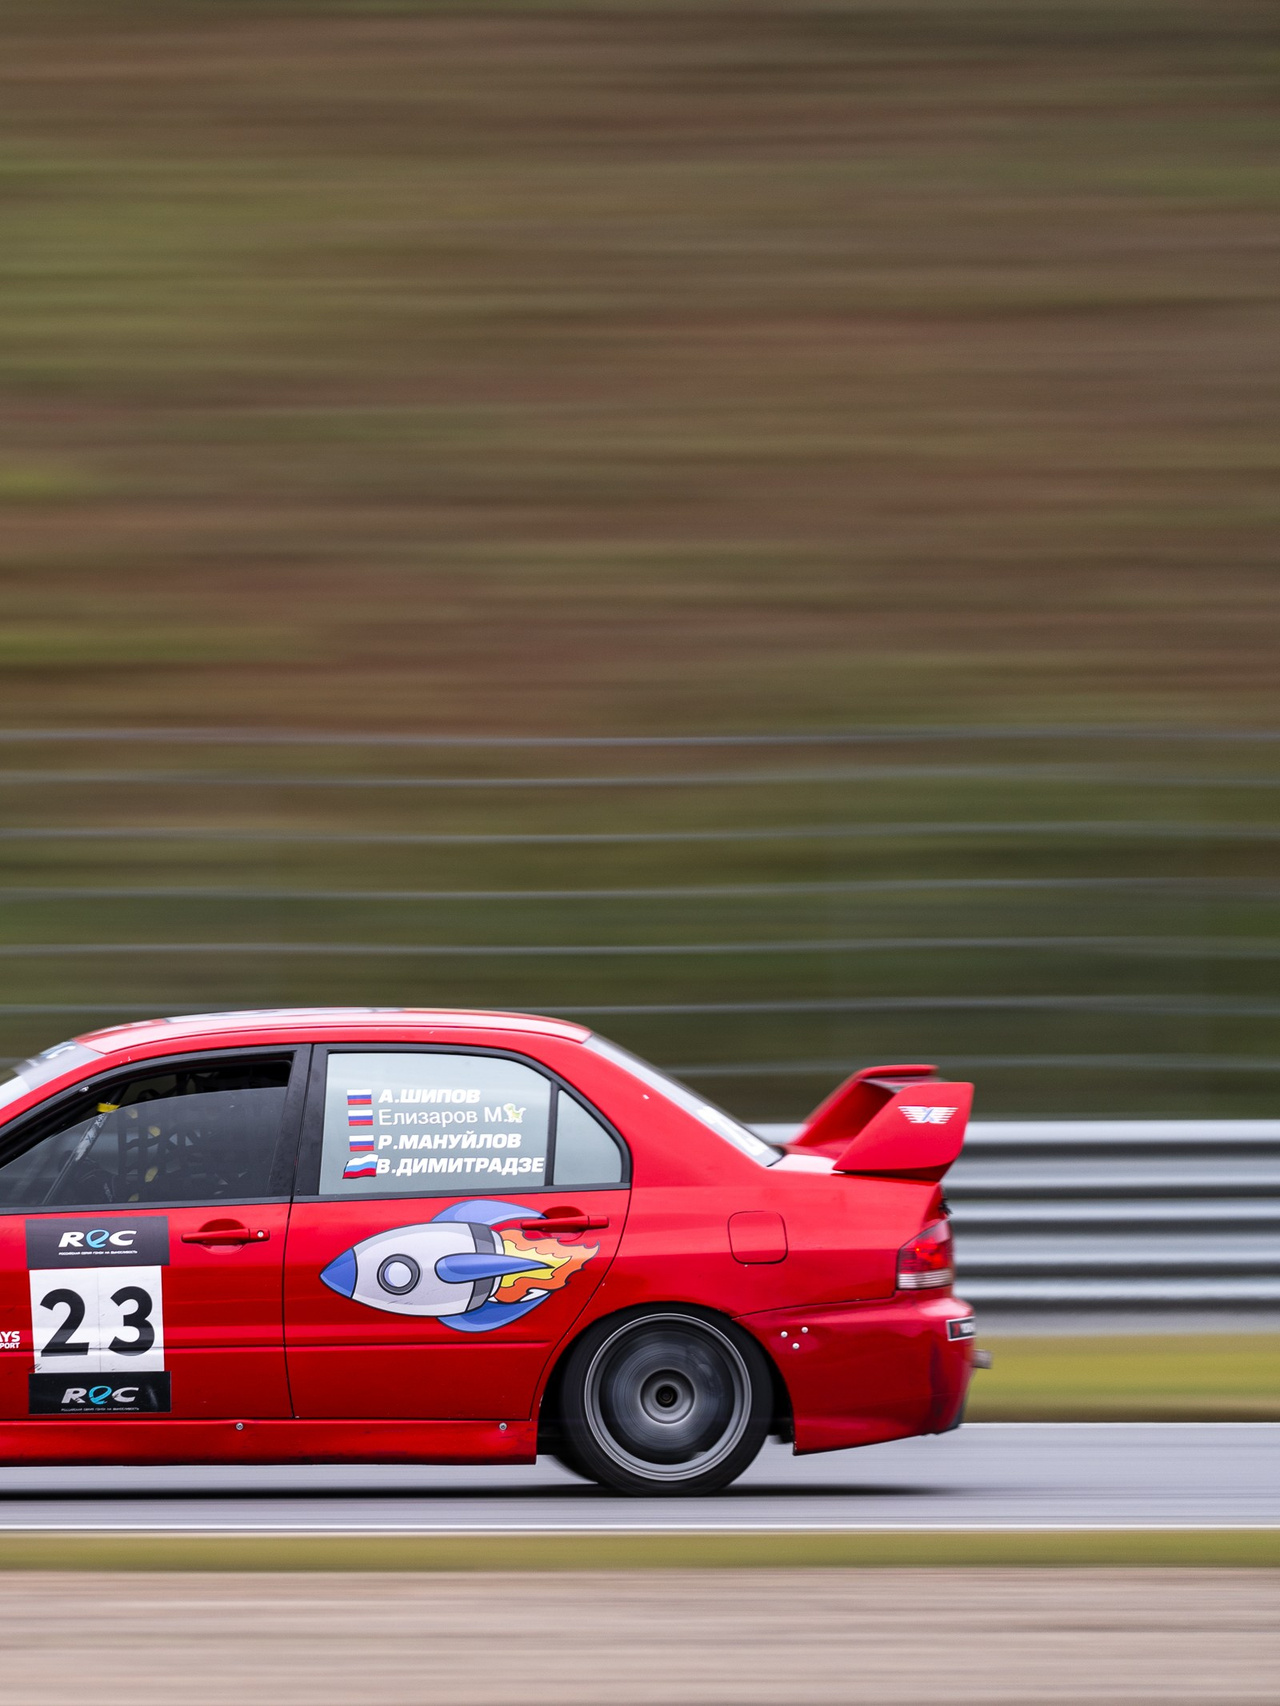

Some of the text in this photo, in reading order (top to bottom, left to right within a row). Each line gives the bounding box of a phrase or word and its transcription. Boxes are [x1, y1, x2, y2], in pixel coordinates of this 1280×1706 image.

[378, 1088, 481, 1104] А.ШИПОВ
[378, 1108, 478, 1127] Елизаров
[378, 1131, 522, 1150] Р.МАНУЙЛОВ
[377, 1157, 545, 1176] В.ДИМИТРАДЗЕ
[39, 1286, 155, 1357] 23
